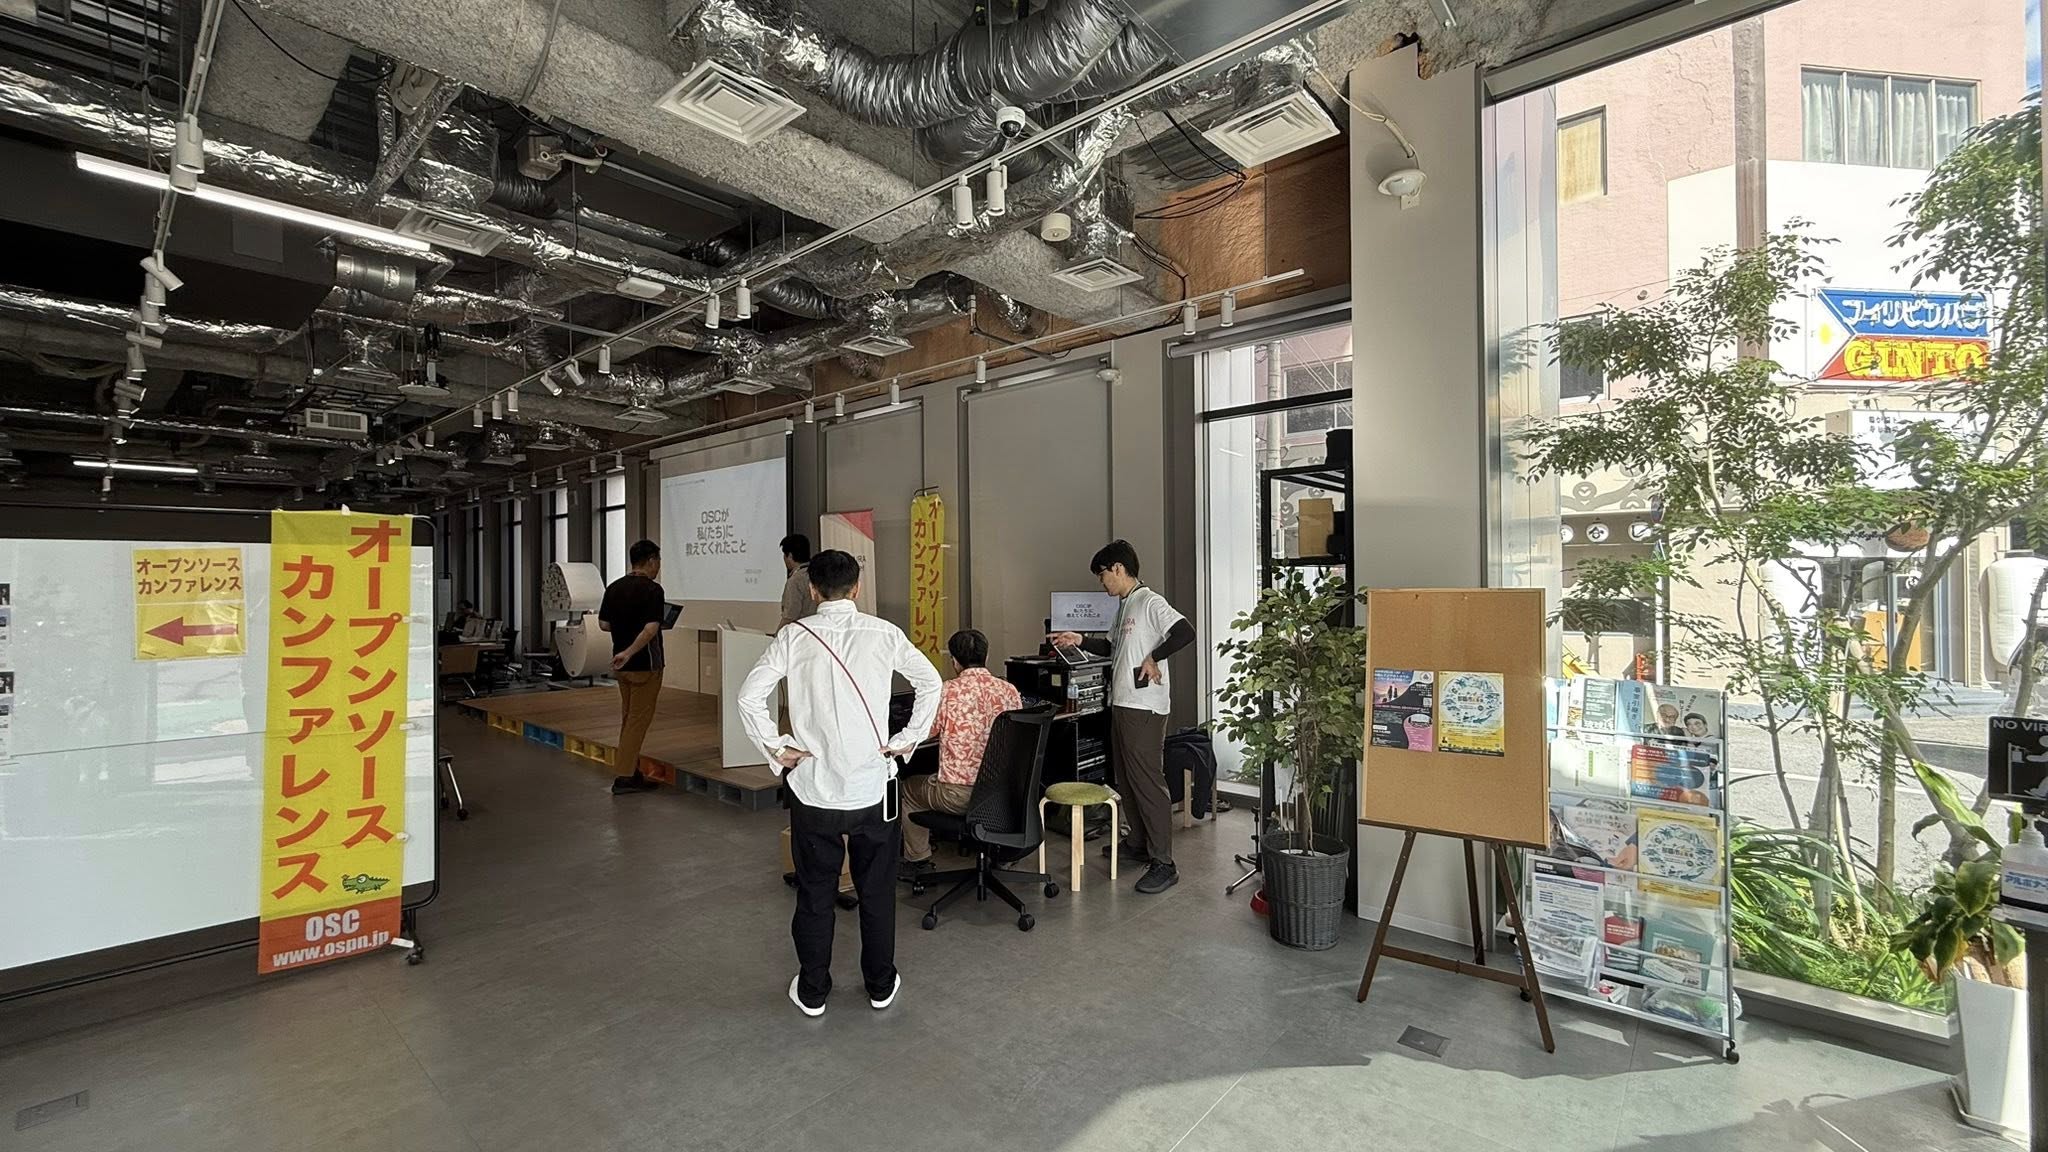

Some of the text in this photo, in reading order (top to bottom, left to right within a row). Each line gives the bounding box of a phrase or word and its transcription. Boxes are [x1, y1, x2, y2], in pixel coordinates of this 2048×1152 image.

[1844, 340, 1986, 379] GINTO
[701, 508, 729, 525] OSCが
[685, 539, 747, 557] 教えてくれたこと
[136, 557, 241, 575] オープンソース
[929, 501, 941, 654] オープンソース
[138, 576, 242, 595] カンファレンス
[914, 518, 926, 648] カンファレン
[342, 519, 402, 849] オープンソース
[271, 555, 335, 899] カンファレンス
[1992, 719, 2018, 730] NO
[2005, 875, 2048, 889] アルボナー
[305, 909, 360, 942] OSC
[272, 930, 390, 967] www.ospn.jp
